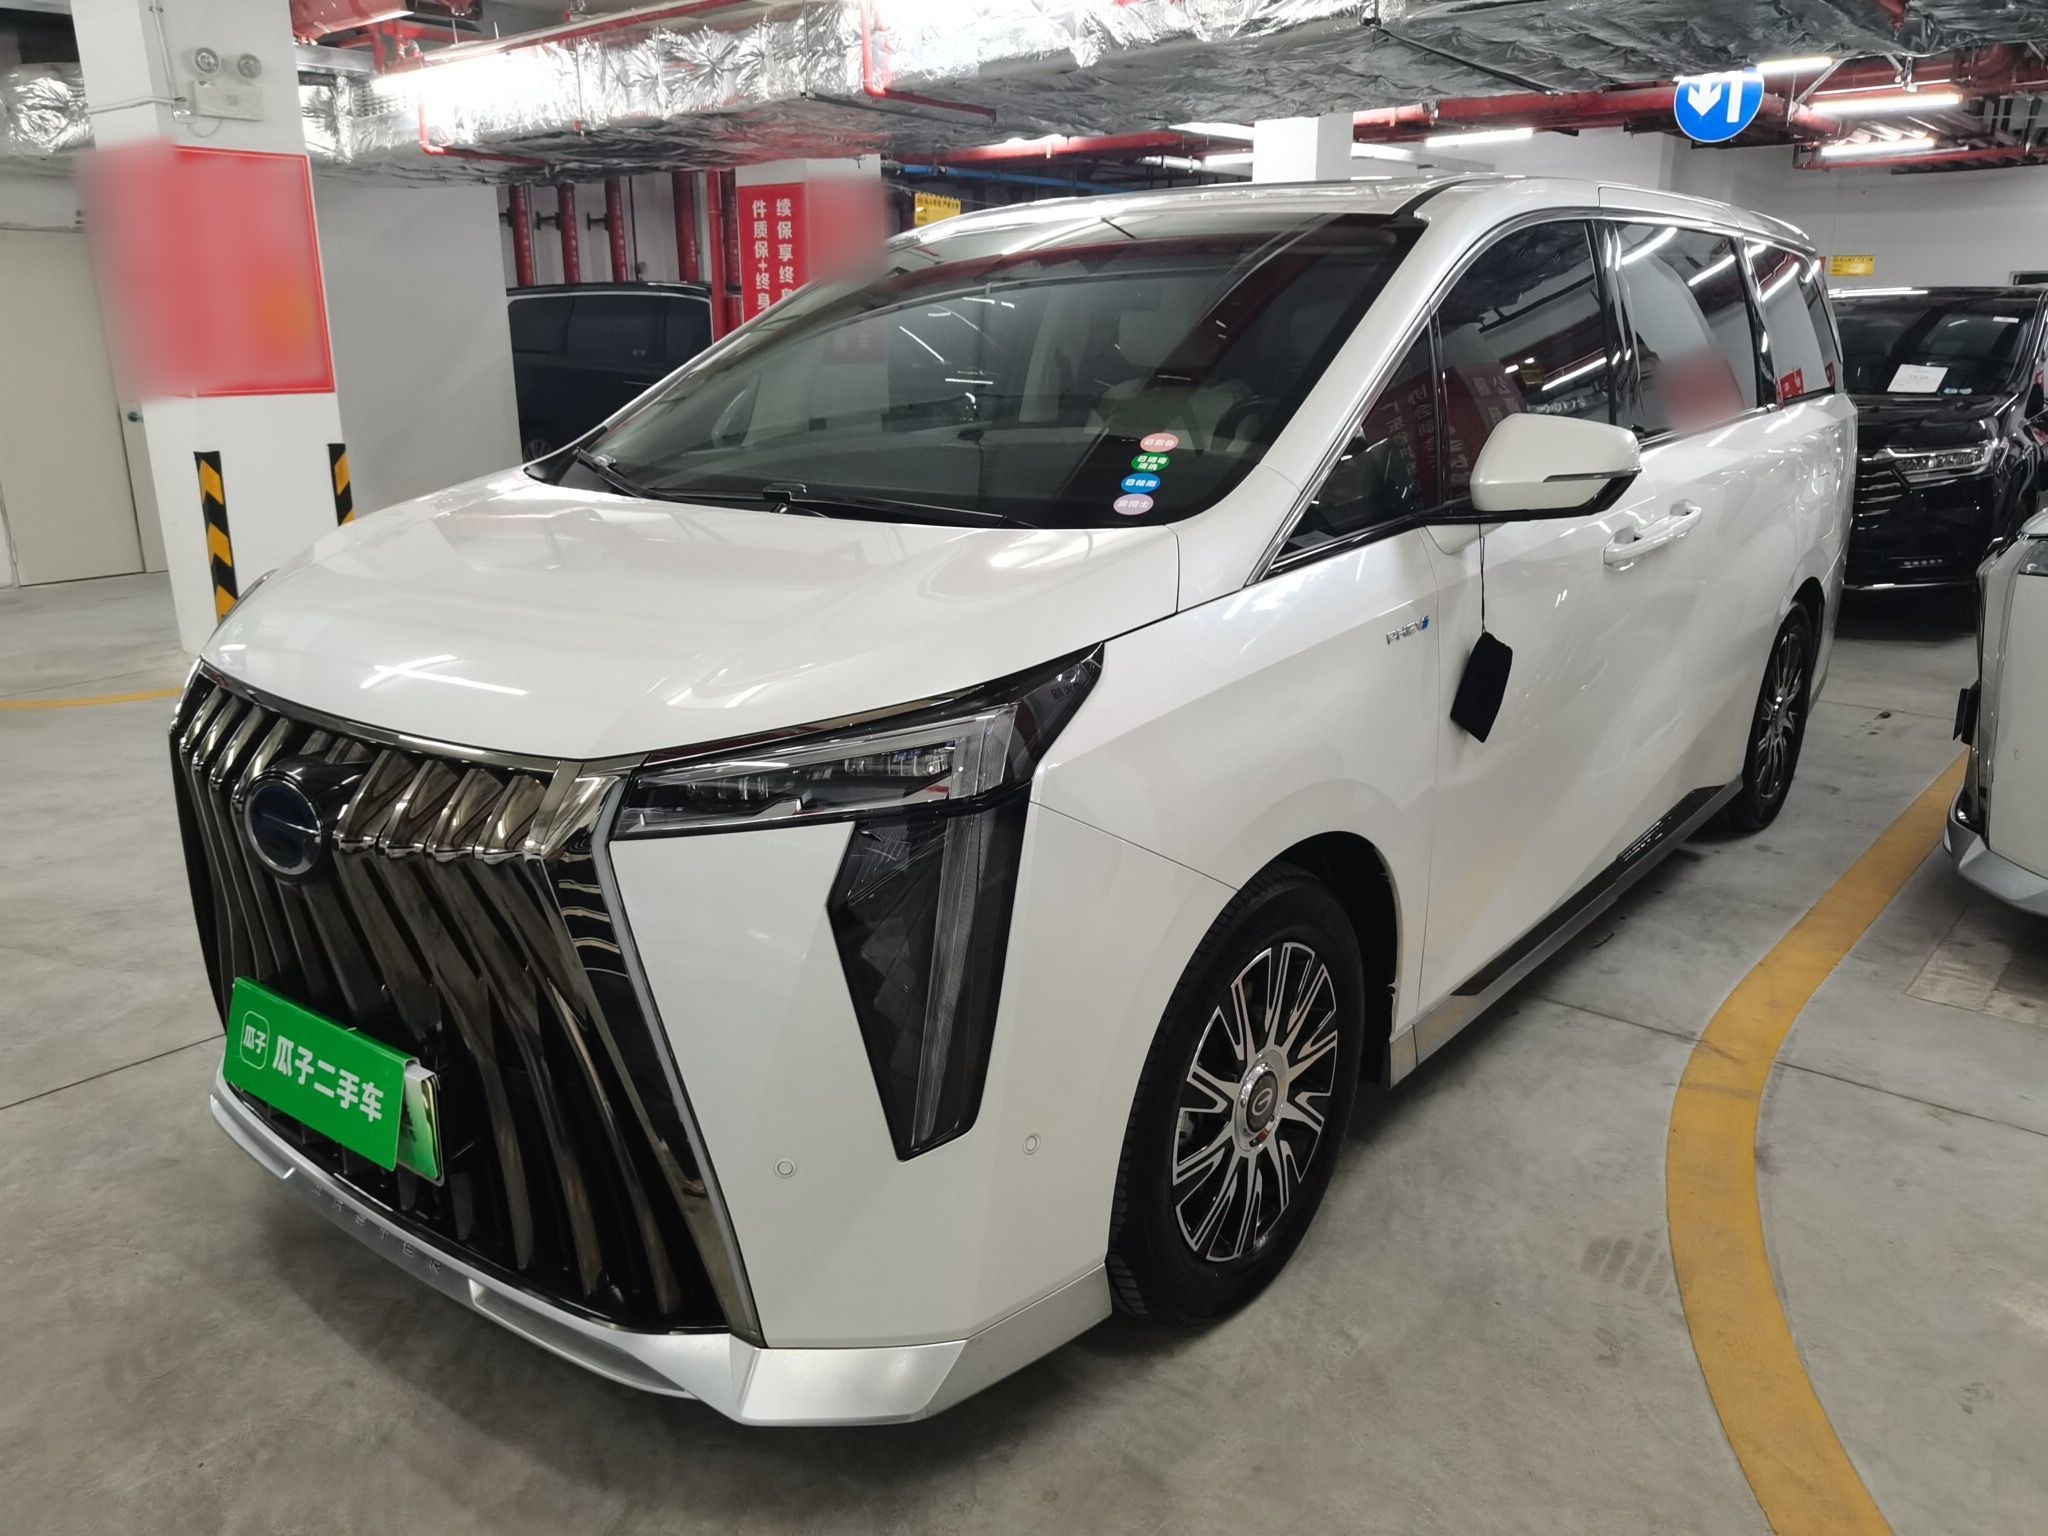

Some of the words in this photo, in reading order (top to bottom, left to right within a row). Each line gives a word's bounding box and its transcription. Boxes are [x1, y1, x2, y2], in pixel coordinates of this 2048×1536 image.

[242, 1025, 267, 1055] 瓜子
[272, 1034, 385, 1123] 瓜子二手车
